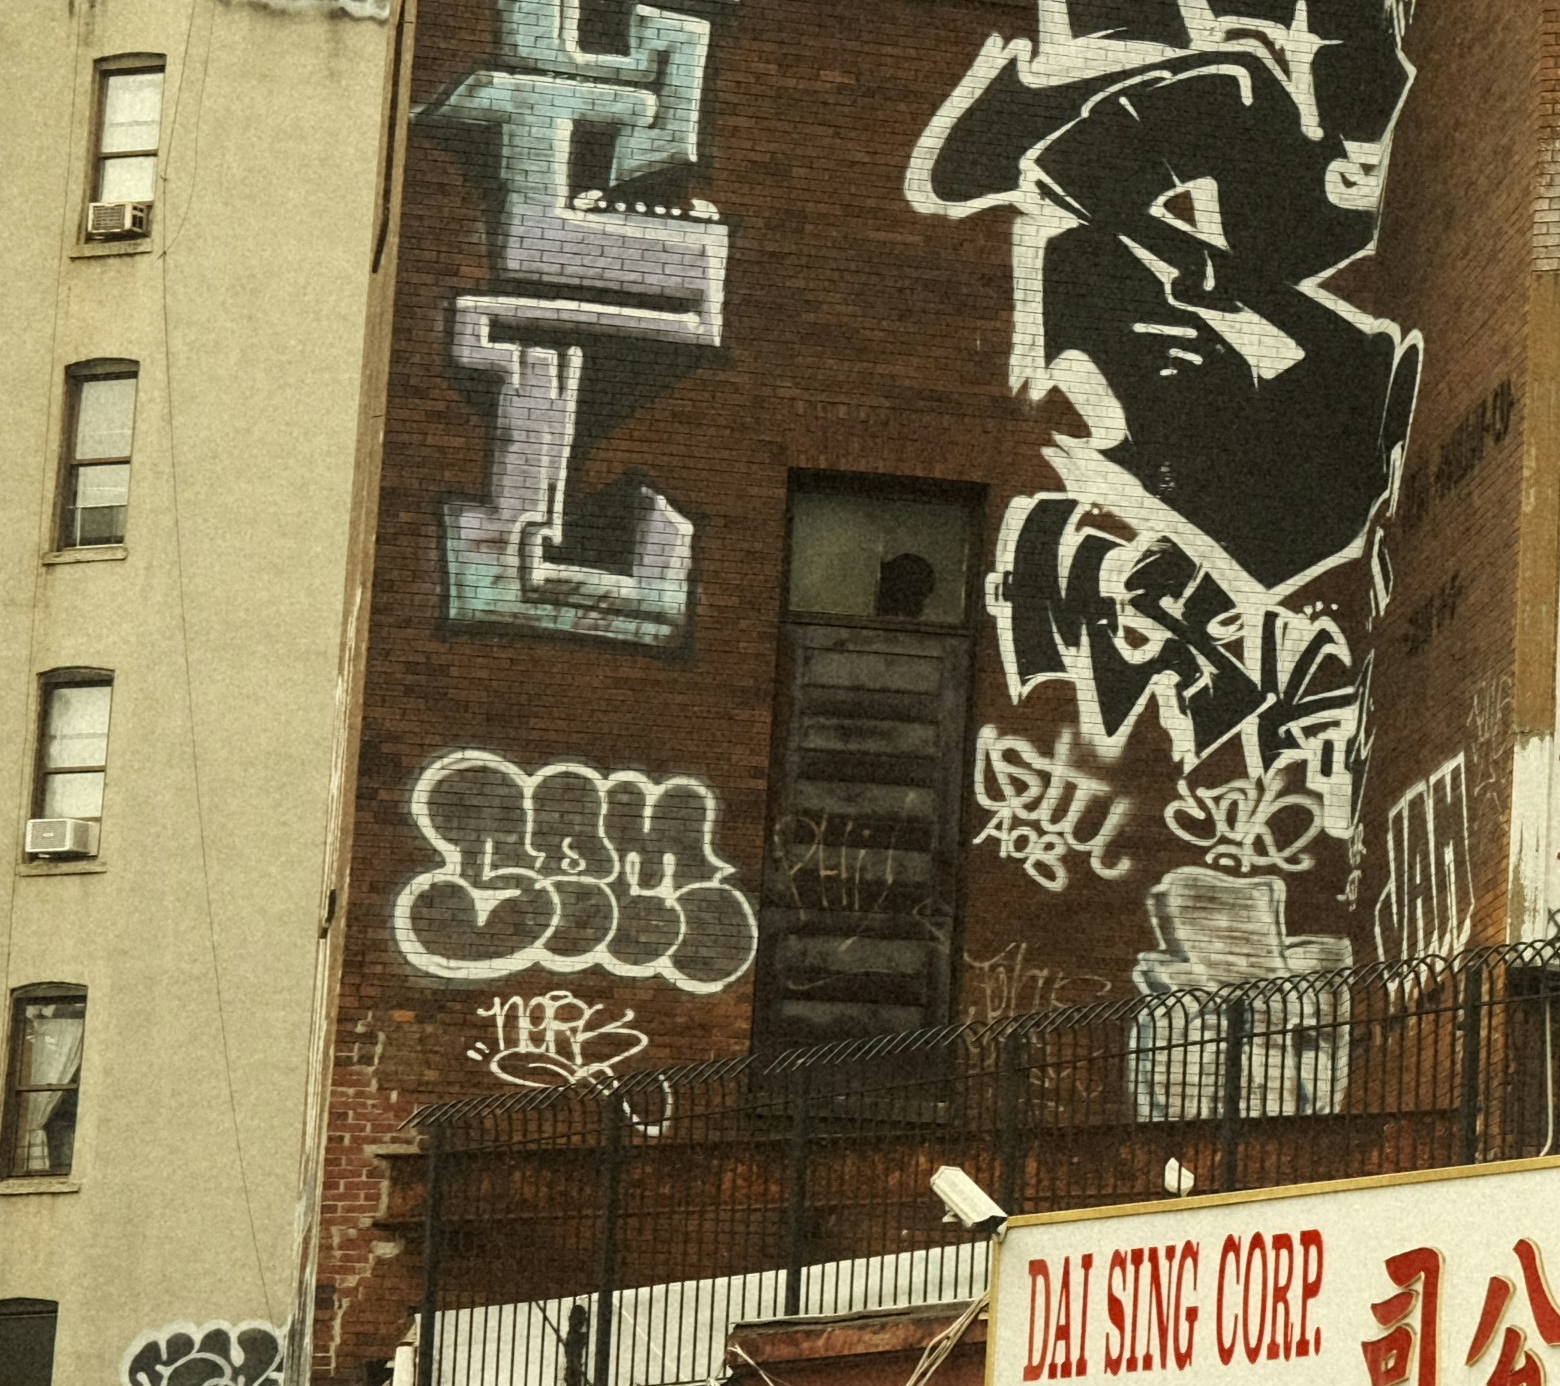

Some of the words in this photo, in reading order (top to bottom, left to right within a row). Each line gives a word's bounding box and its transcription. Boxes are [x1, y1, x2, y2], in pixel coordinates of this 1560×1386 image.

[1022, 1254, 1094, 1382] DAI
[1104, 1240, 1200, 1376] SING
[1215, 1228, 1325, 1366] CORP.
